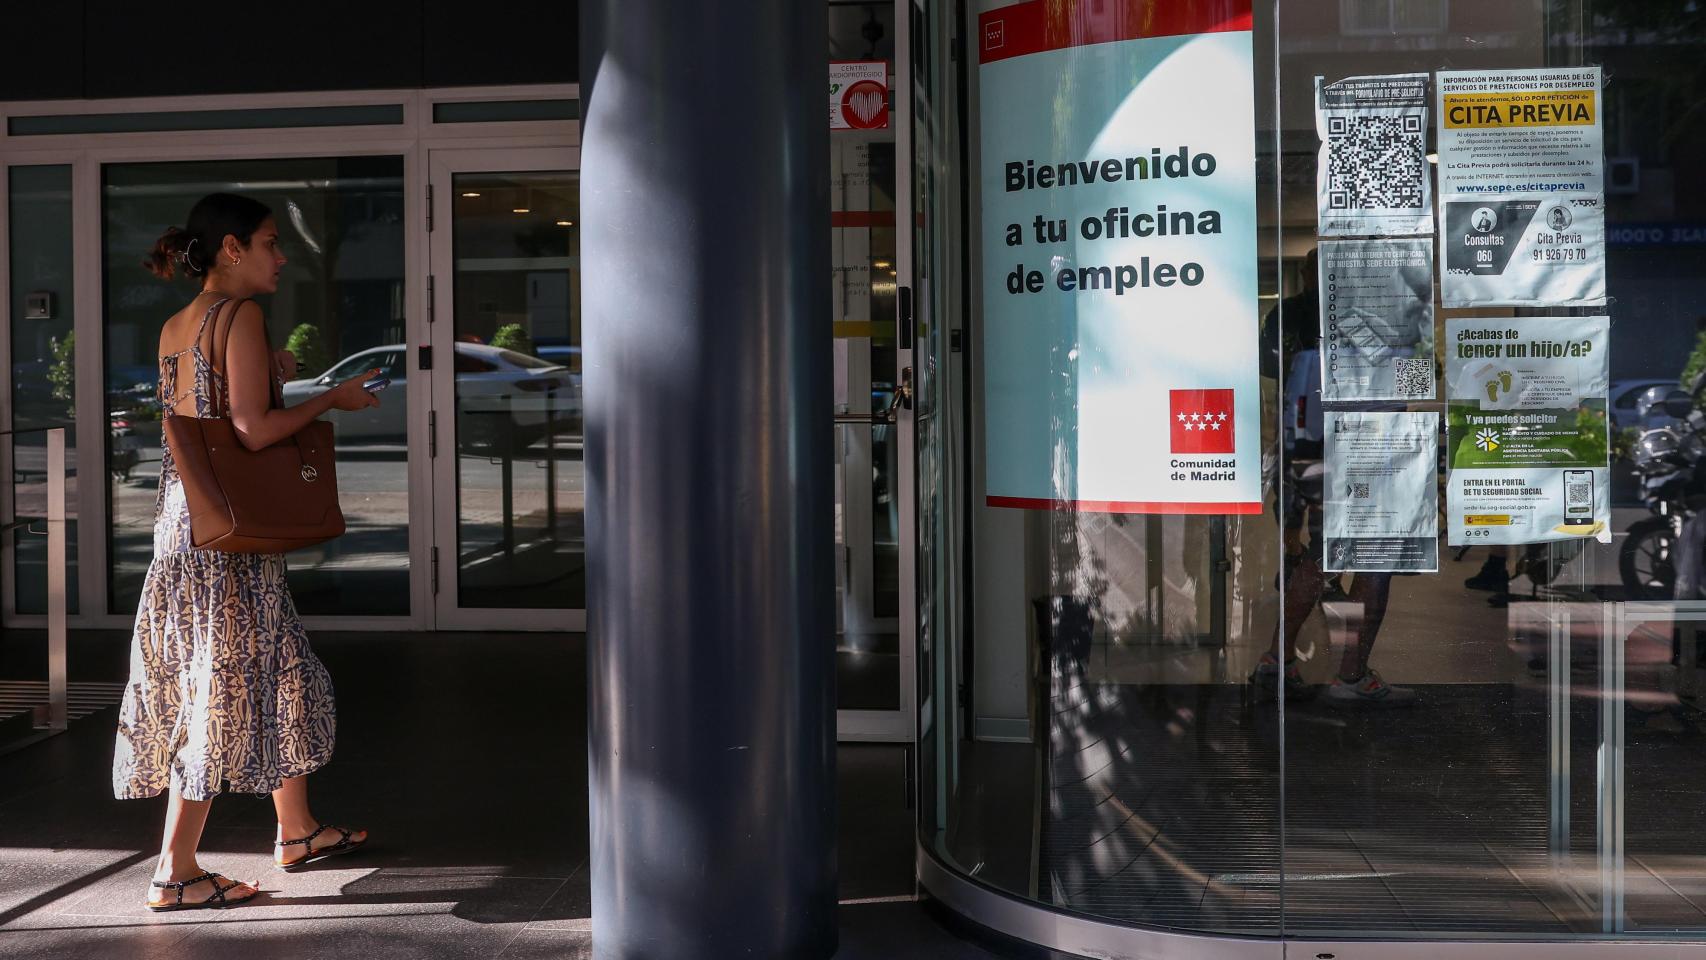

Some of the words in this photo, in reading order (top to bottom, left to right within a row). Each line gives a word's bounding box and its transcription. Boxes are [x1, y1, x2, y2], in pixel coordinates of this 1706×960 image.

[1356, 88, 1383, 98] FORMULARIO
[1385, 88, 1390, 97] DE
[1450, 106, 1502, 124] CITA
[1510, 104, 1590, 123] PREVIA
[1005, 146, 1217, 192] Bienvenido
[1492, 161, 1509, 169] podrá
[1457, 182, 1585, 192] www.sepe.es/citaprevia
[1006, 223, 1022, 246] a
[1033, 215, 1067, 244] tu
[1080, 205, 1222, 240] oficina
[1465, 234, 1504, 246] Consultas
[1538, 233, 1553, 244] Cita
[1557, 233, 1582, 243] Previa
[1477, 250, 1492, 261] 060
[1534, 250, 1544, 260] 91
[1546, 249, 1560, 260] 926
[1564, 249, 1573, 260] 79
[1577, 249, 1586, 259] 70
[1384, 258, 1426, 267] ELECTRÓNICA
[1006, 264, 1044, 294] de
[1056, 257, 1205, 296] empleo
[1458, 329, 1503, 341] ¿Acabas
[1506, 329, 1518, 339] de
[1458, 343, 1502, 358] tener
[1506, 343, 1527, 357] un
[1531, 340, 1592, 359] hijo/a?
[1466, 415, 1471, 424] Y
[1473, 416, 1483, 424] ya
[1485, 415, 1518, 424] puedes
[1520, 415, 1558, 423] solicitar
[1170, 459, 1235, 468] Comunidad
[1170, 472, 1186, 480] de
[1190, 471, 1235, 480] Madrid
